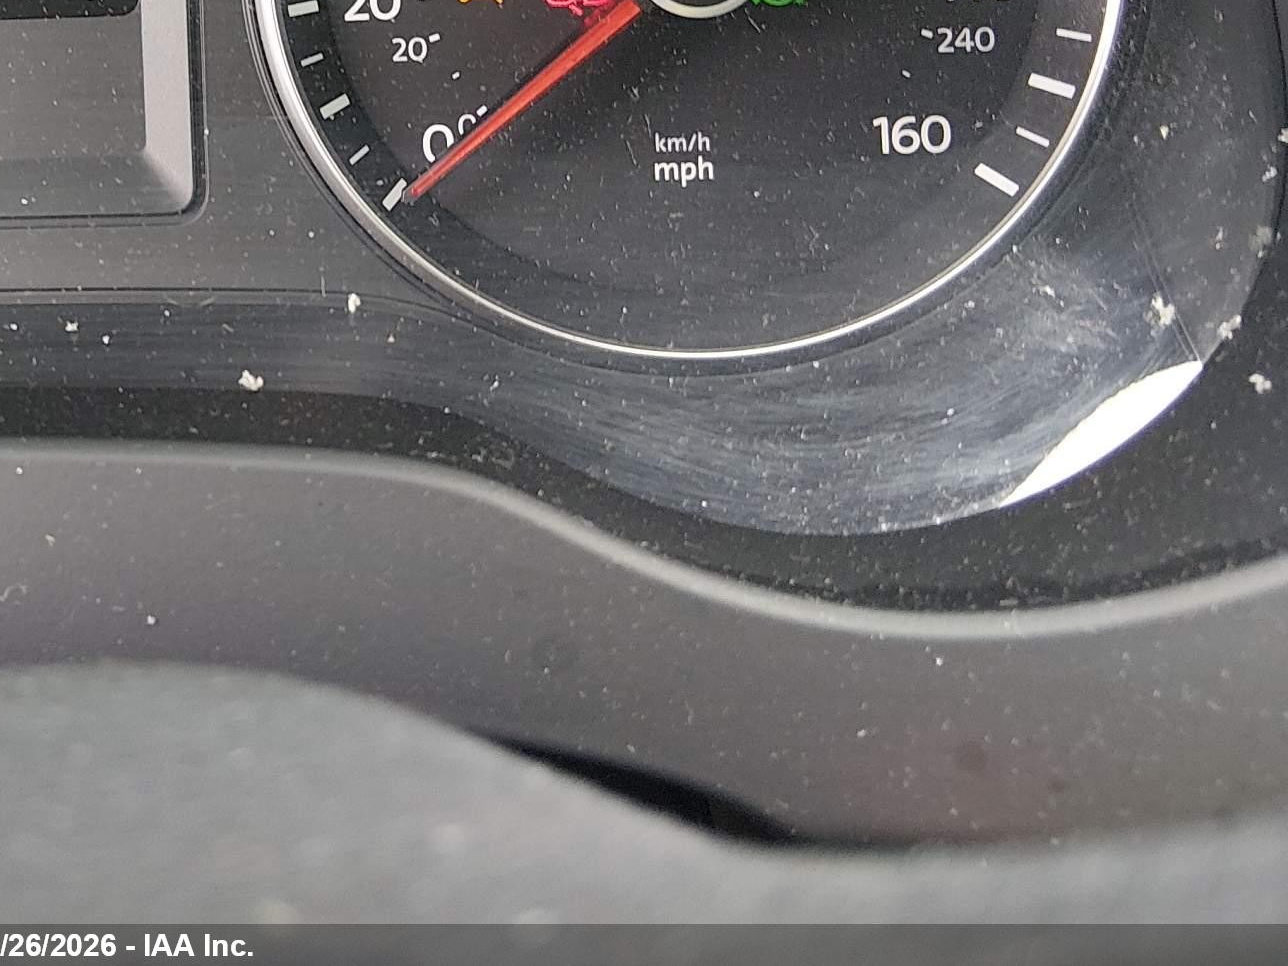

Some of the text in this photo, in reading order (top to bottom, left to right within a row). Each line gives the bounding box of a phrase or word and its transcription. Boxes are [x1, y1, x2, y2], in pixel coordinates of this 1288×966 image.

[392, 36, 428, 64] 20
[937, 26, 996, 55] 240
[654, 133, 711, 155] km/h
[872, 115, 952, 154] 160
[654, 156, 715, 187] mph
